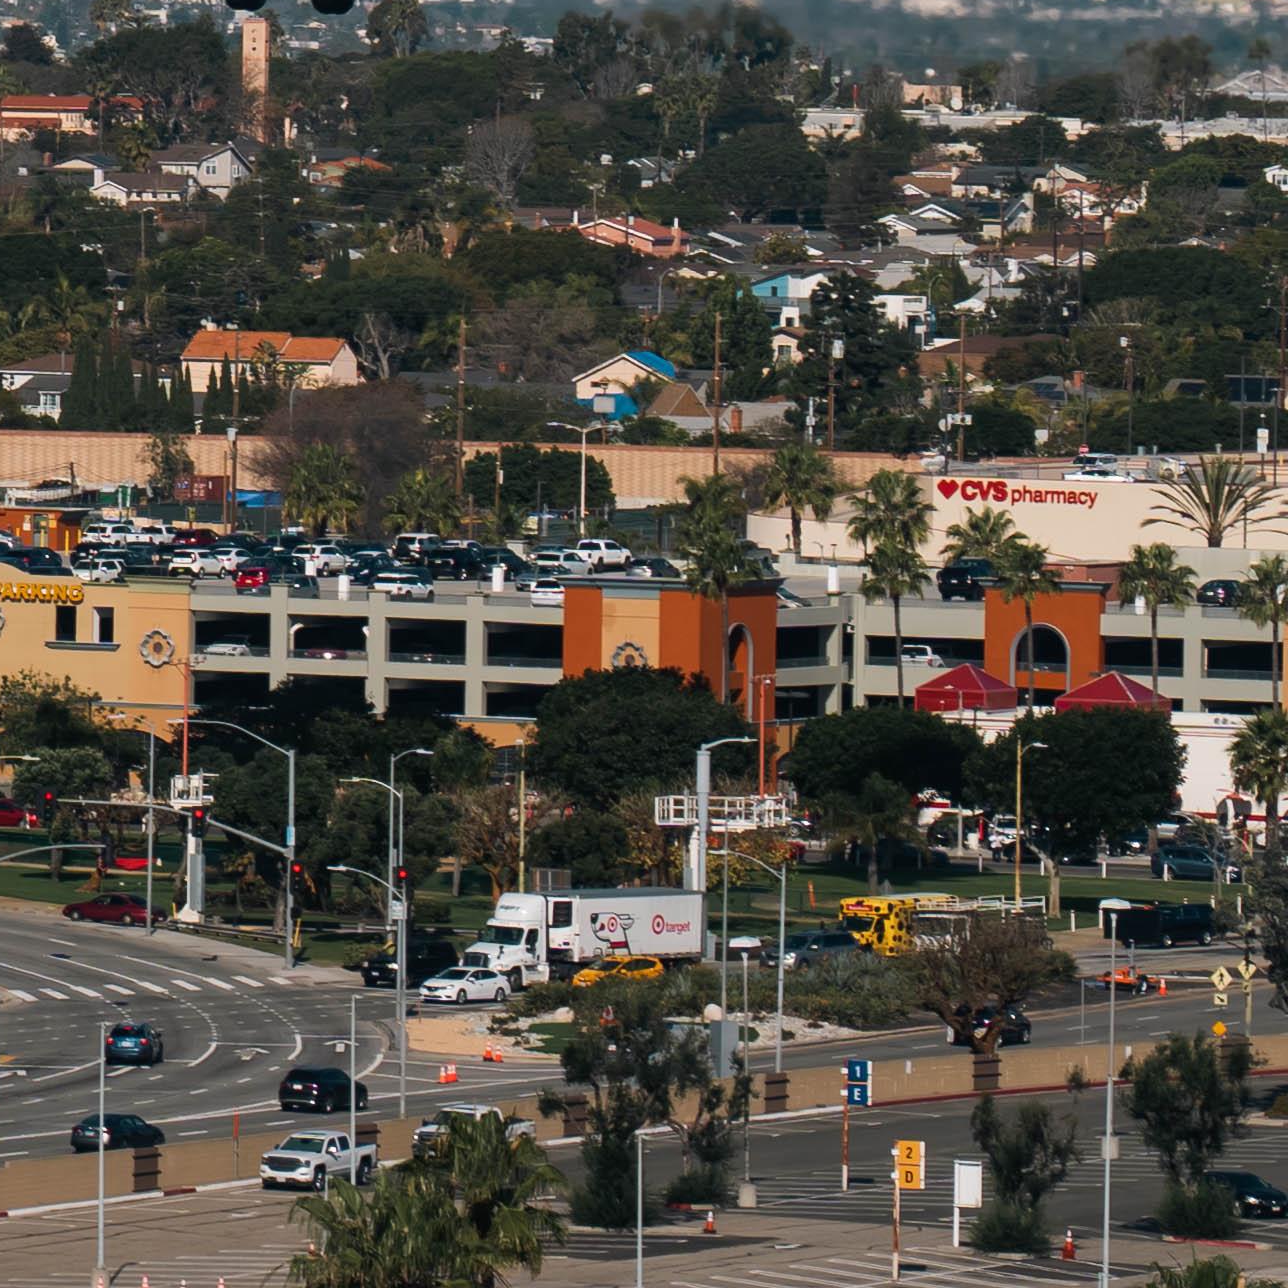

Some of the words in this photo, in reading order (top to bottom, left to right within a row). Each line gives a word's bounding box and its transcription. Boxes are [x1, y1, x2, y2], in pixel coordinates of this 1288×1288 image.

[960, 479, 1009, 503] CVS
[1010, 484, 1098, 509] pharmacy
[665, 921, 691, 935] target
[854, 1065, 861, 1078] 1
[853, 1088, 862, 1101] E
[905, 1146, 913, 1159] 2
[904, 1170, 914, 1184] D
